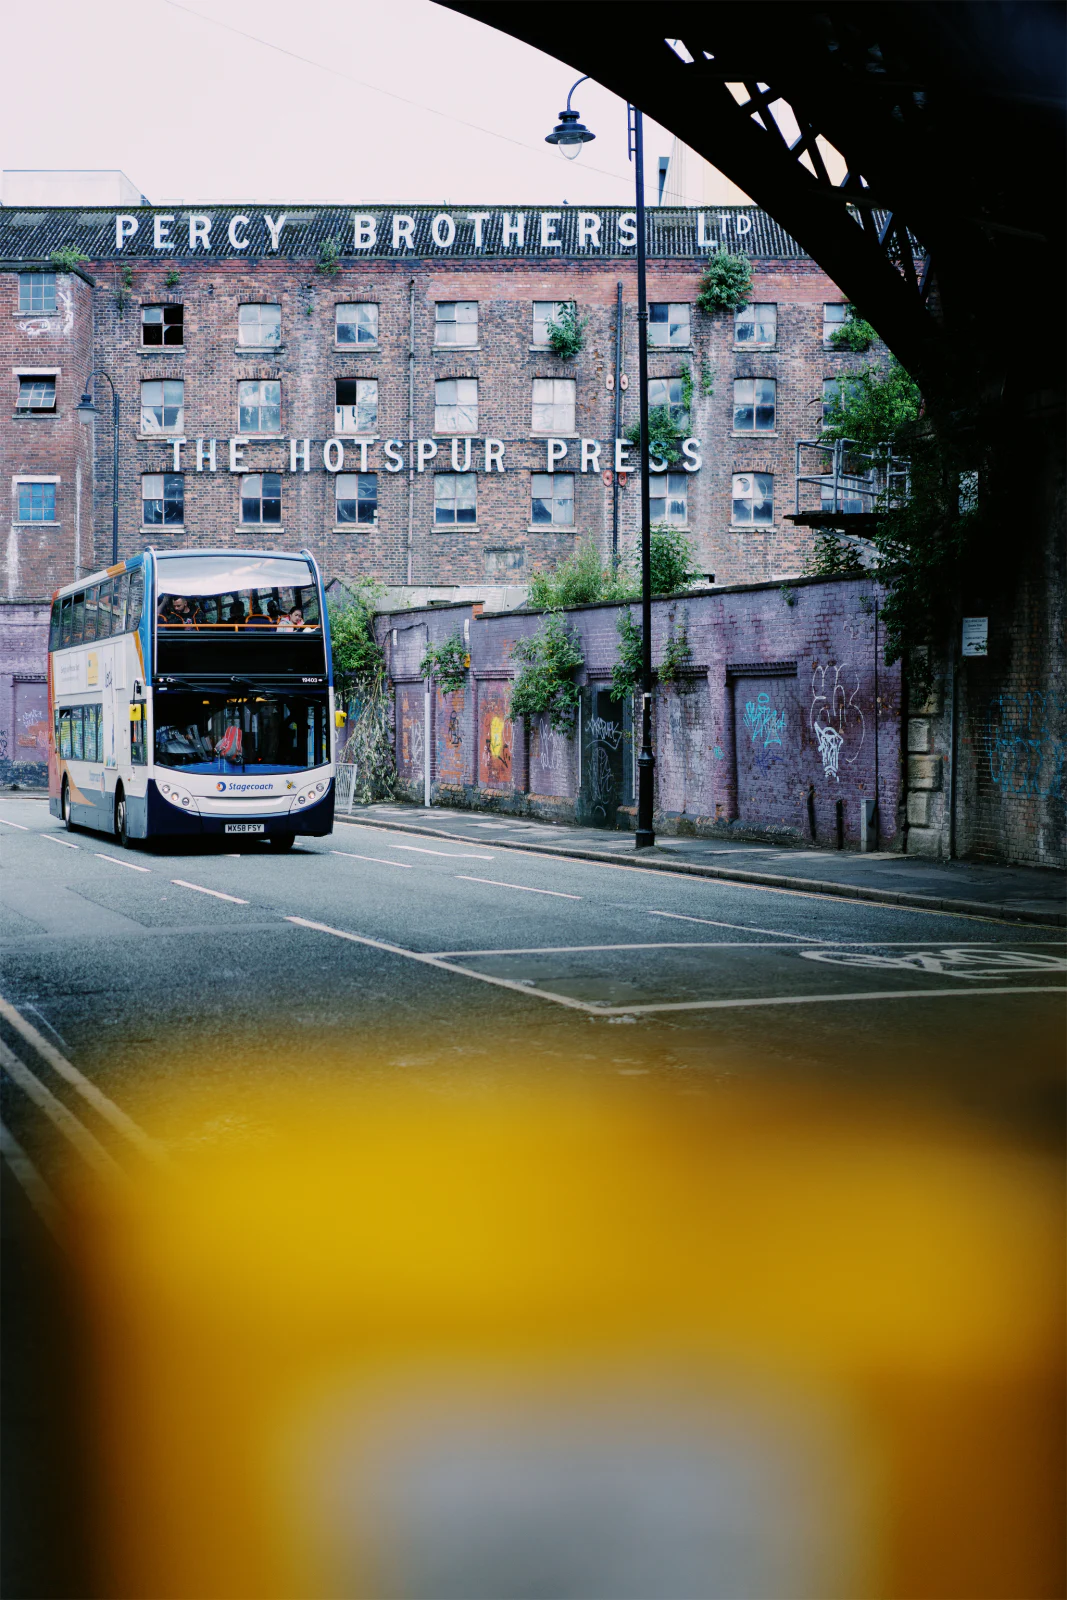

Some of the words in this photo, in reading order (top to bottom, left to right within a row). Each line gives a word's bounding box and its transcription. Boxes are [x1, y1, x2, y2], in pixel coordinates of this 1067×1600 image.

[115, 214, 287, 249] PERCY
[354, 212, 637, 249] BROTHERS
[697, 212, 752, 247] LTD
[167, 438, 249, 472] THE
[290, 438, 505, 473] HOTSPUR
[547, 438, 702, 473] PRESS
[229, 782, 274, 793] Stagecoach
[227, 824, 246, 832] MX58
[247, 824, 262, 832] FSY
